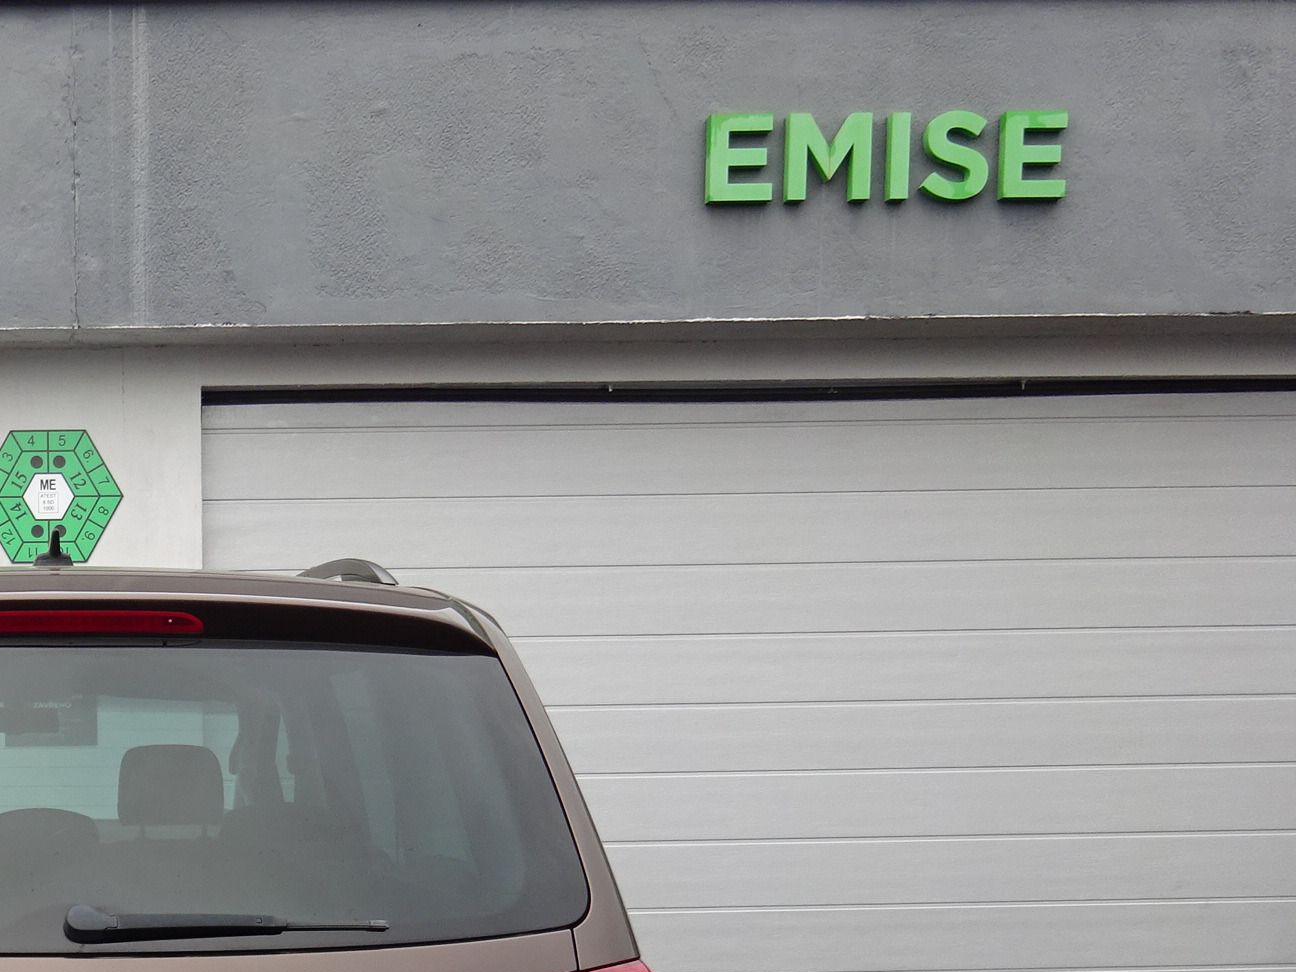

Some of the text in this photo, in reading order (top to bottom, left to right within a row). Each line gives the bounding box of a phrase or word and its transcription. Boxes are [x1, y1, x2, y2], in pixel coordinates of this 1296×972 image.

[705, 110, 1070, 205] EMISE
[27, 435, 35, 446] 4
[58, 435, 66, 446] 5
[2, 452, 14, 462] 3
[11, 472, 28, 490] 15
[39, 479, 57, 491] ME
[70, 472, 87, 490] 12
[98, 476, 110, 485] 7
[10, 502, 27, 520] 14
[70, 502, 87, 521] 13
[98, 506, 109, 516] 8
[2, 530, 16, 546] 12
